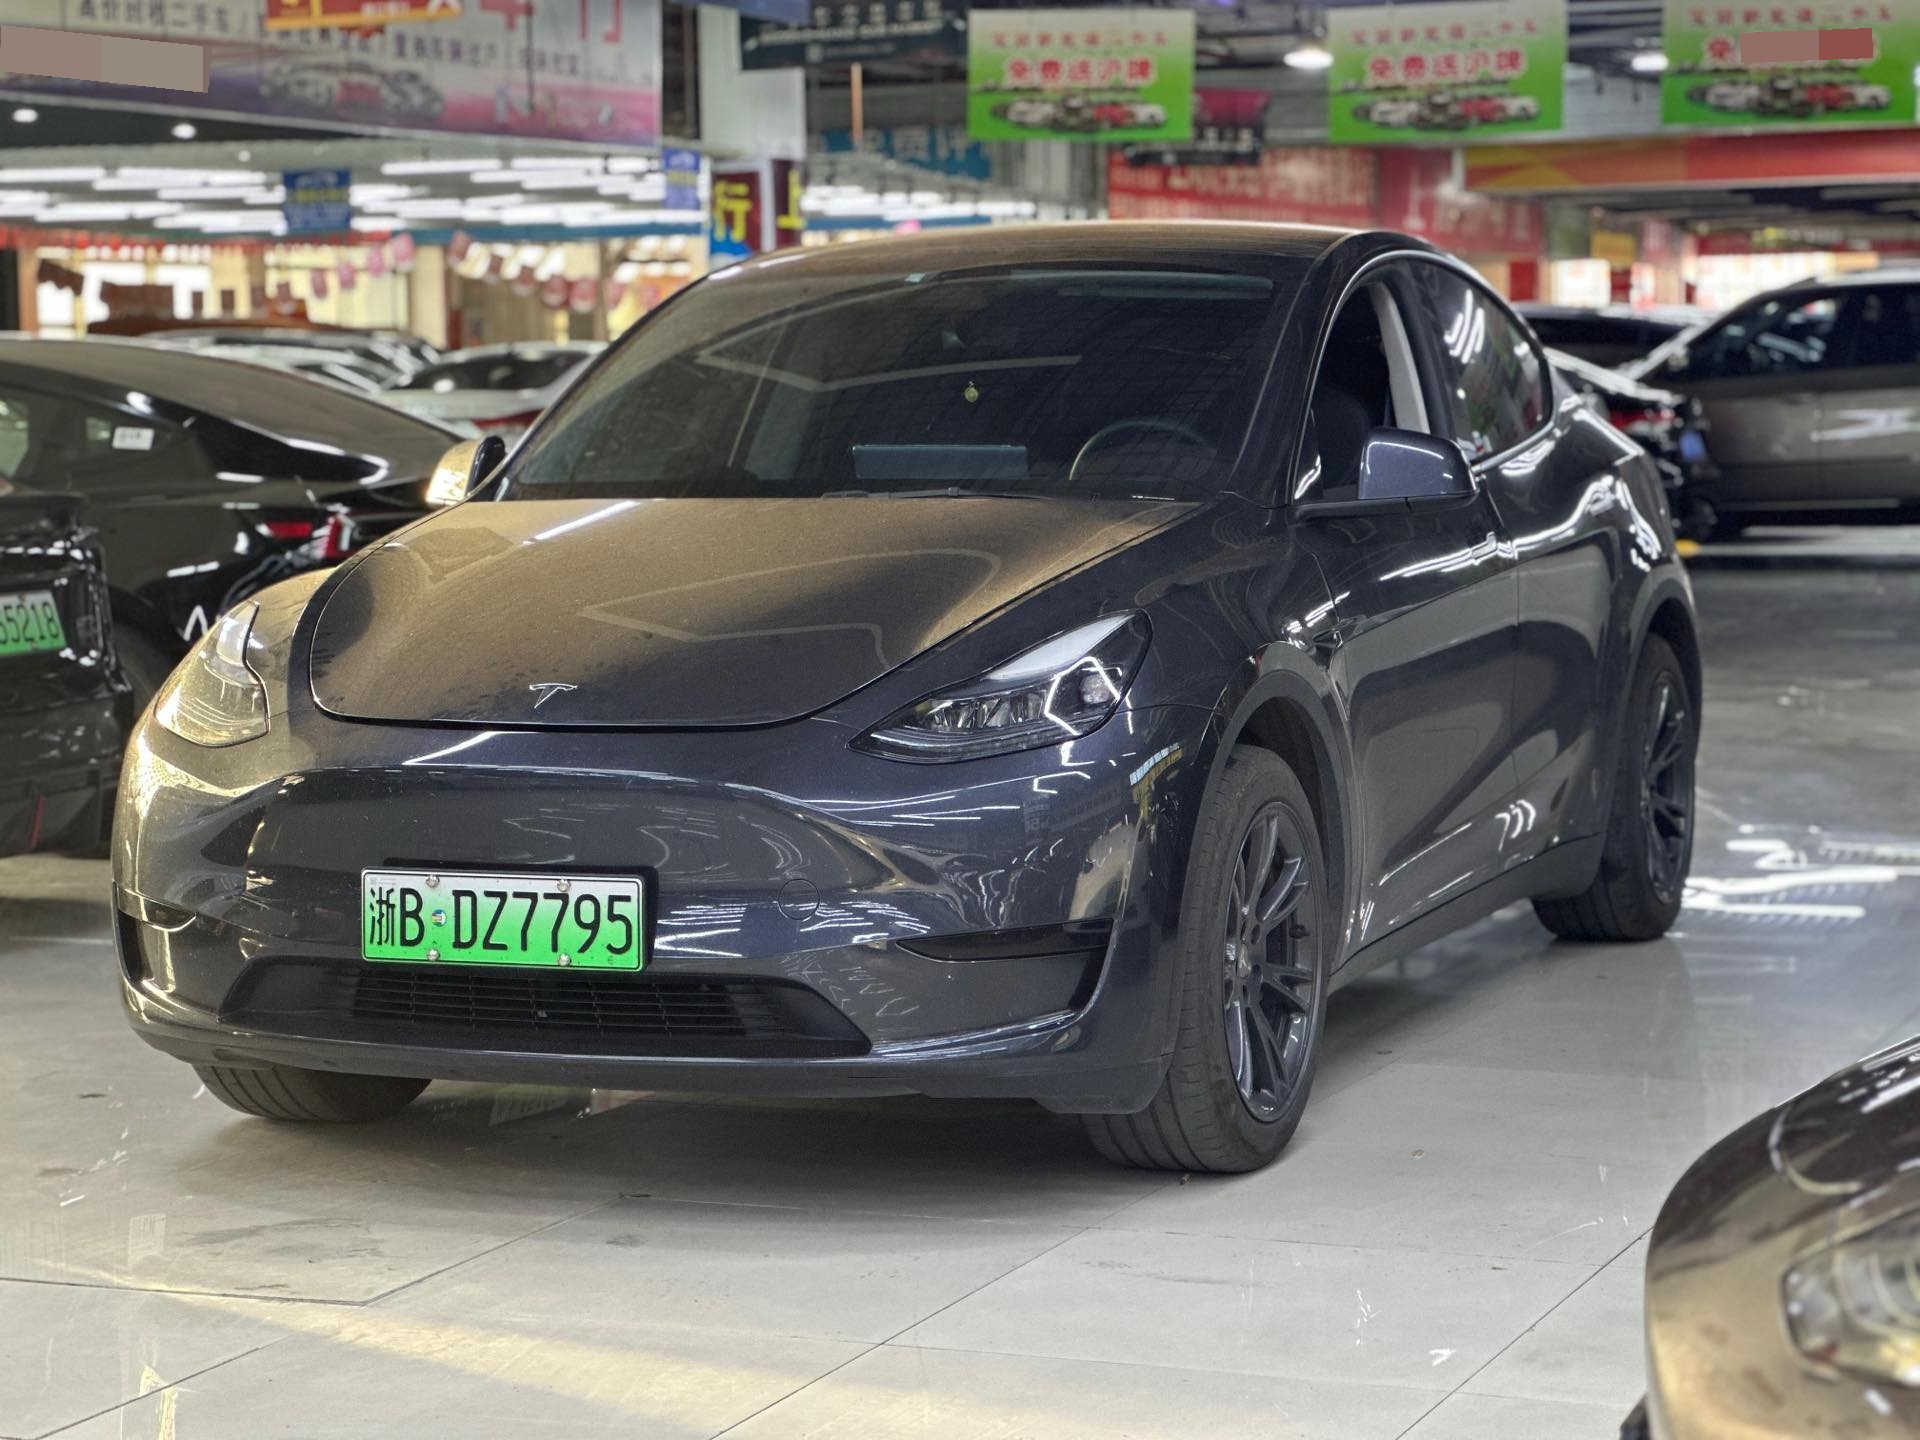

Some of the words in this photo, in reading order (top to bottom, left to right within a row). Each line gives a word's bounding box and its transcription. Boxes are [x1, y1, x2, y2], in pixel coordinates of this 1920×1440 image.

[1008, 56, 1154, 82] 免费送沪牌
[1369, 48, 1522, 79] 免费送沪牌
[713, 179, 752, 243] 行
